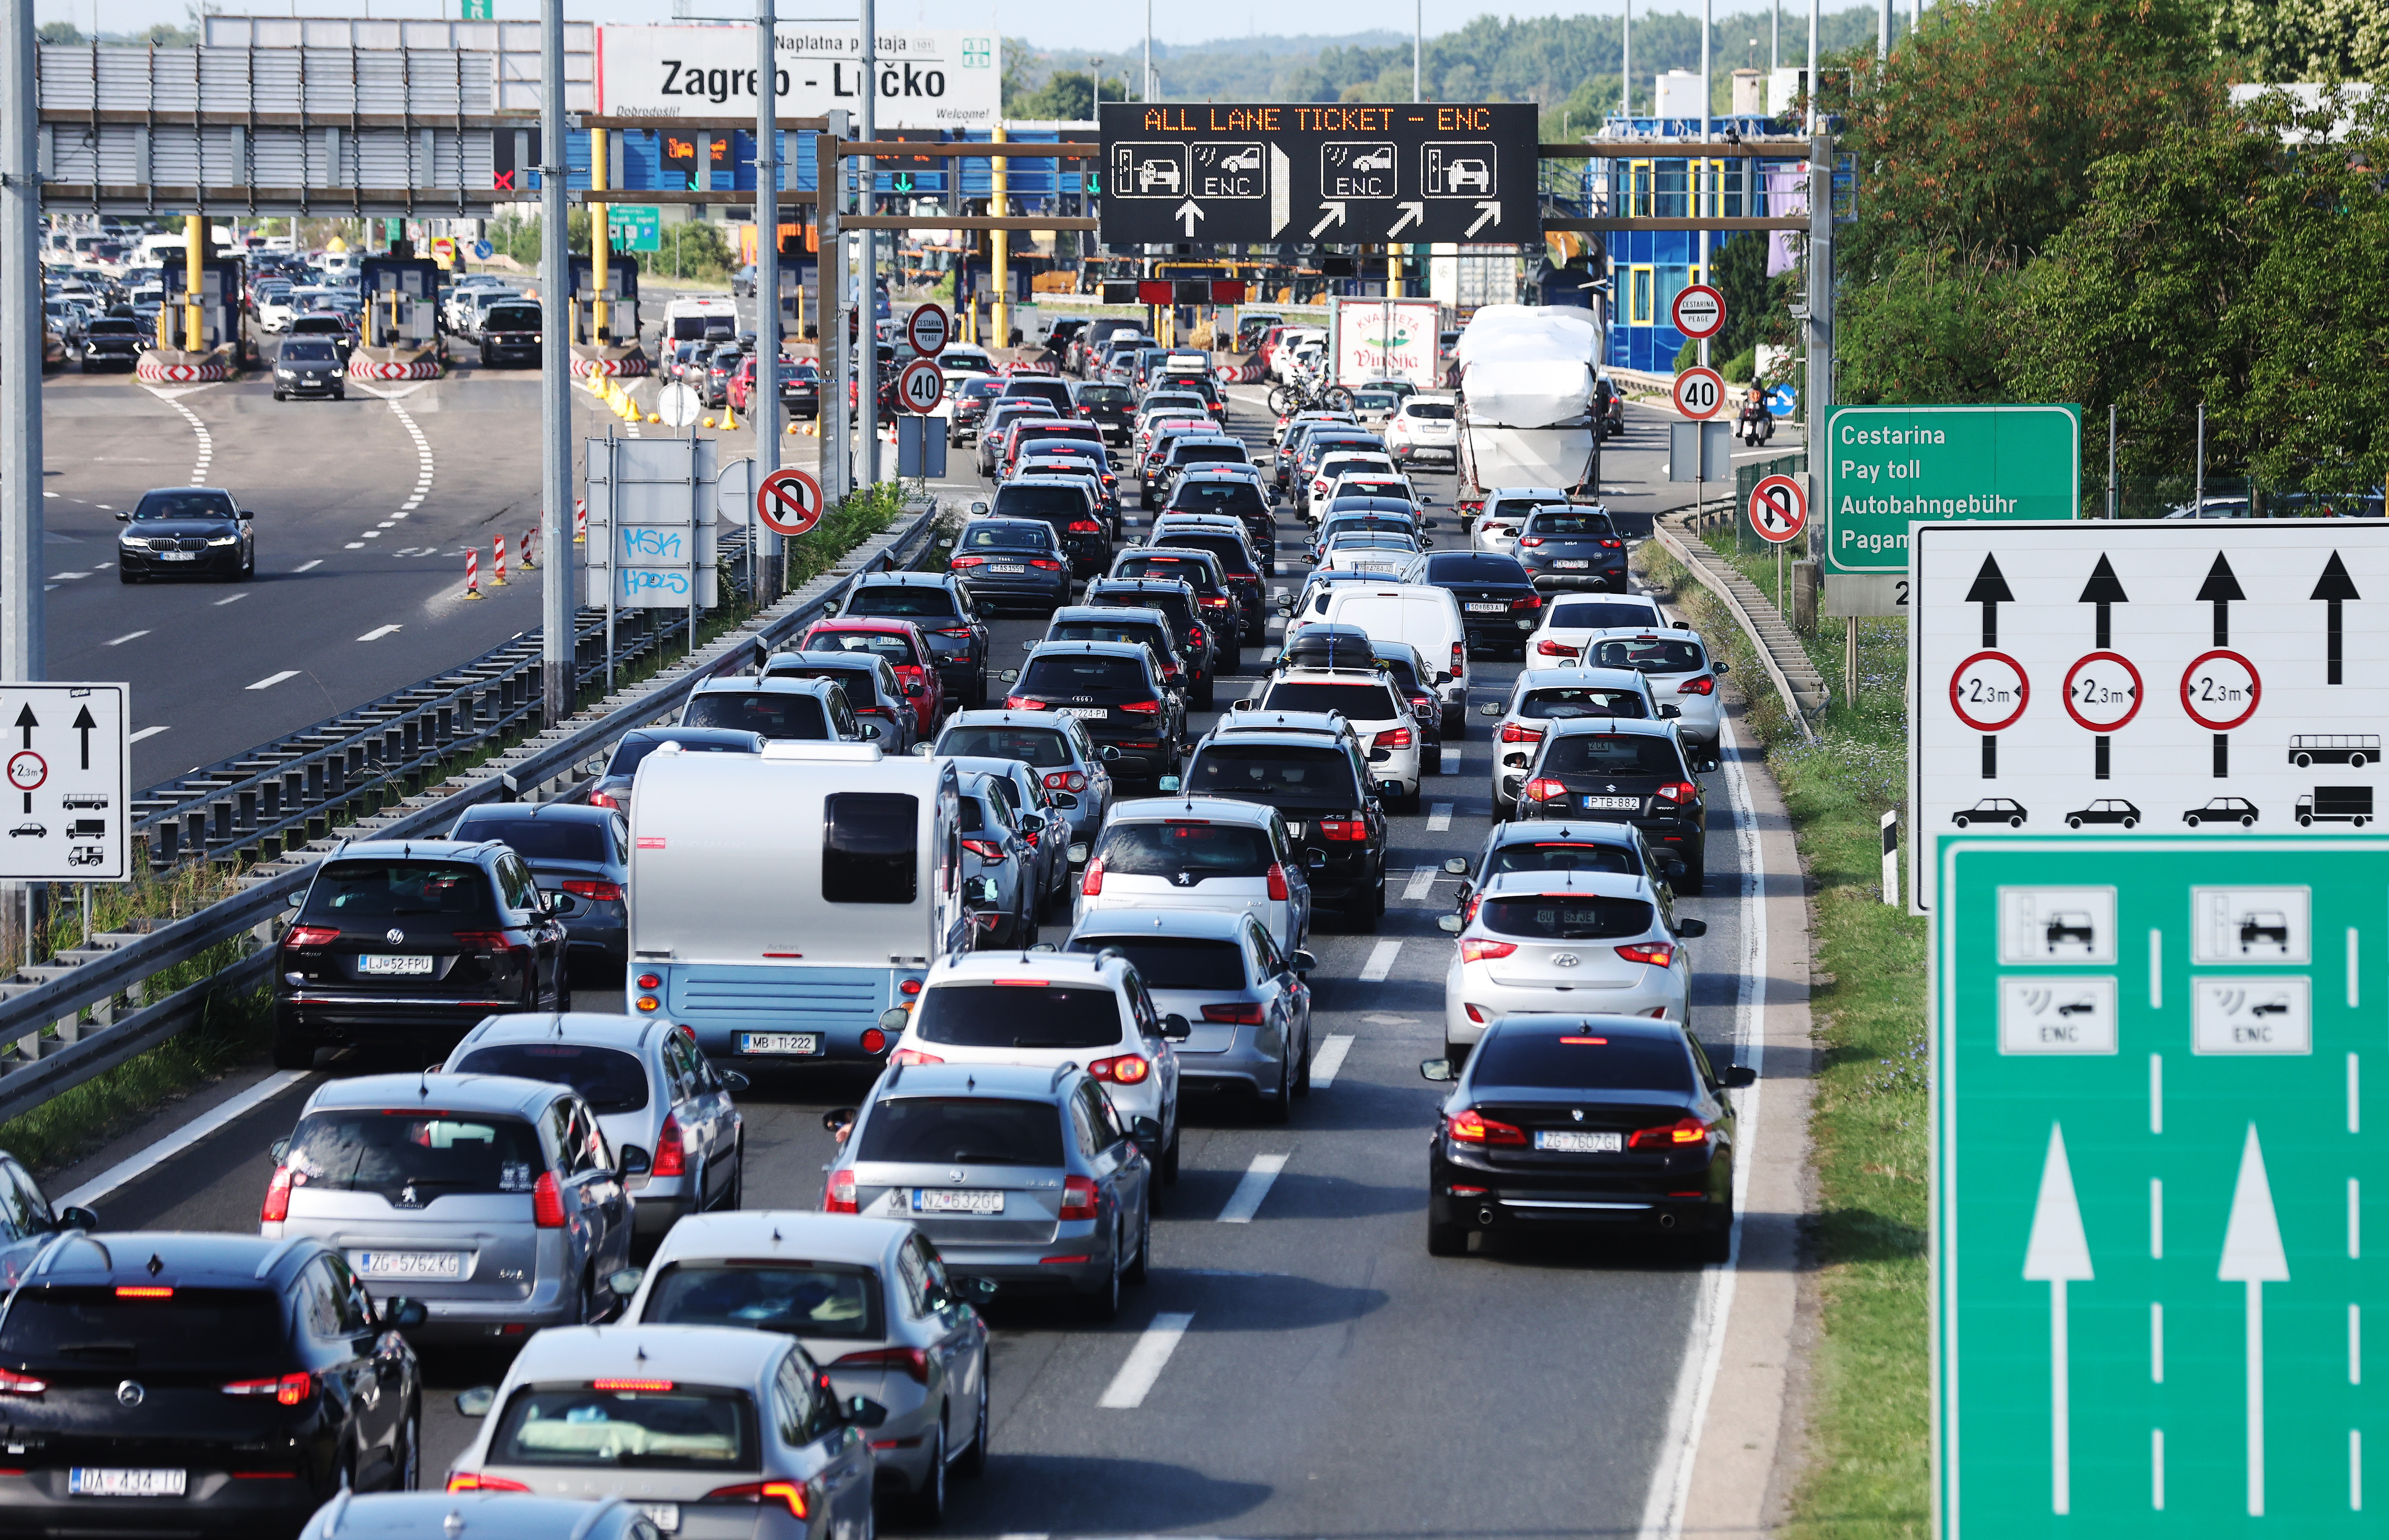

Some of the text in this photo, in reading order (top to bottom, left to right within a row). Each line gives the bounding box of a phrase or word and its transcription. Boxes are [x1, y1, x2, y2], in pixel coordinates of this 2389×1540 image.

[775, 36, 842, 53] Naplatna
[850, 36, 907, 53] ptaja
[661, 60, 790, 103] Zagreb
[936, 107, 990, 120] Welcome!
[1145, 108, 1197, 131] ALL
[1211, 108, 1281, 131] LANE
[1295, 108, 1394, 130] TICKET
[1438, 108, 1490, 130] ENC
[1205, 177, 1250, 195] ENC
[1336, 177, 1382, 195] ENC
[1682, 300, 1715, 308] CESTARINA
[911, 374, 935, 399] 40
[1685, 383, 1714, 406] 40
[1842, 425, 1945, 445] Cestarina
[1842, 459, 1920, 483] Pay toll
[1840, 494, 2018, 519] Autobahngebühr
[624, 528, 681, 558] MSK
[1078, 709, 1106, 717] 224-PA
[1591, 797, 1637, 807] PTB-882
[1539, 912, 1553, 921] GU
[369, 958, 383, 970] LJ
[391, 958, 429, 970] 52-FPU
[753, 1037, 769, 1048] MB
[778, 1037, 810, 1049] TI-222
[2041, 1026, 2080, 1043] ENC
[2234, 1026, 2273, 1043] ENC
[1547, 1134, 1561, 1147] ZG
[924, 1193, 942, 1207] NZ
[952, 1193, 1000, 1209] 632GC
[372, 1254, 389, 1271] ZG
